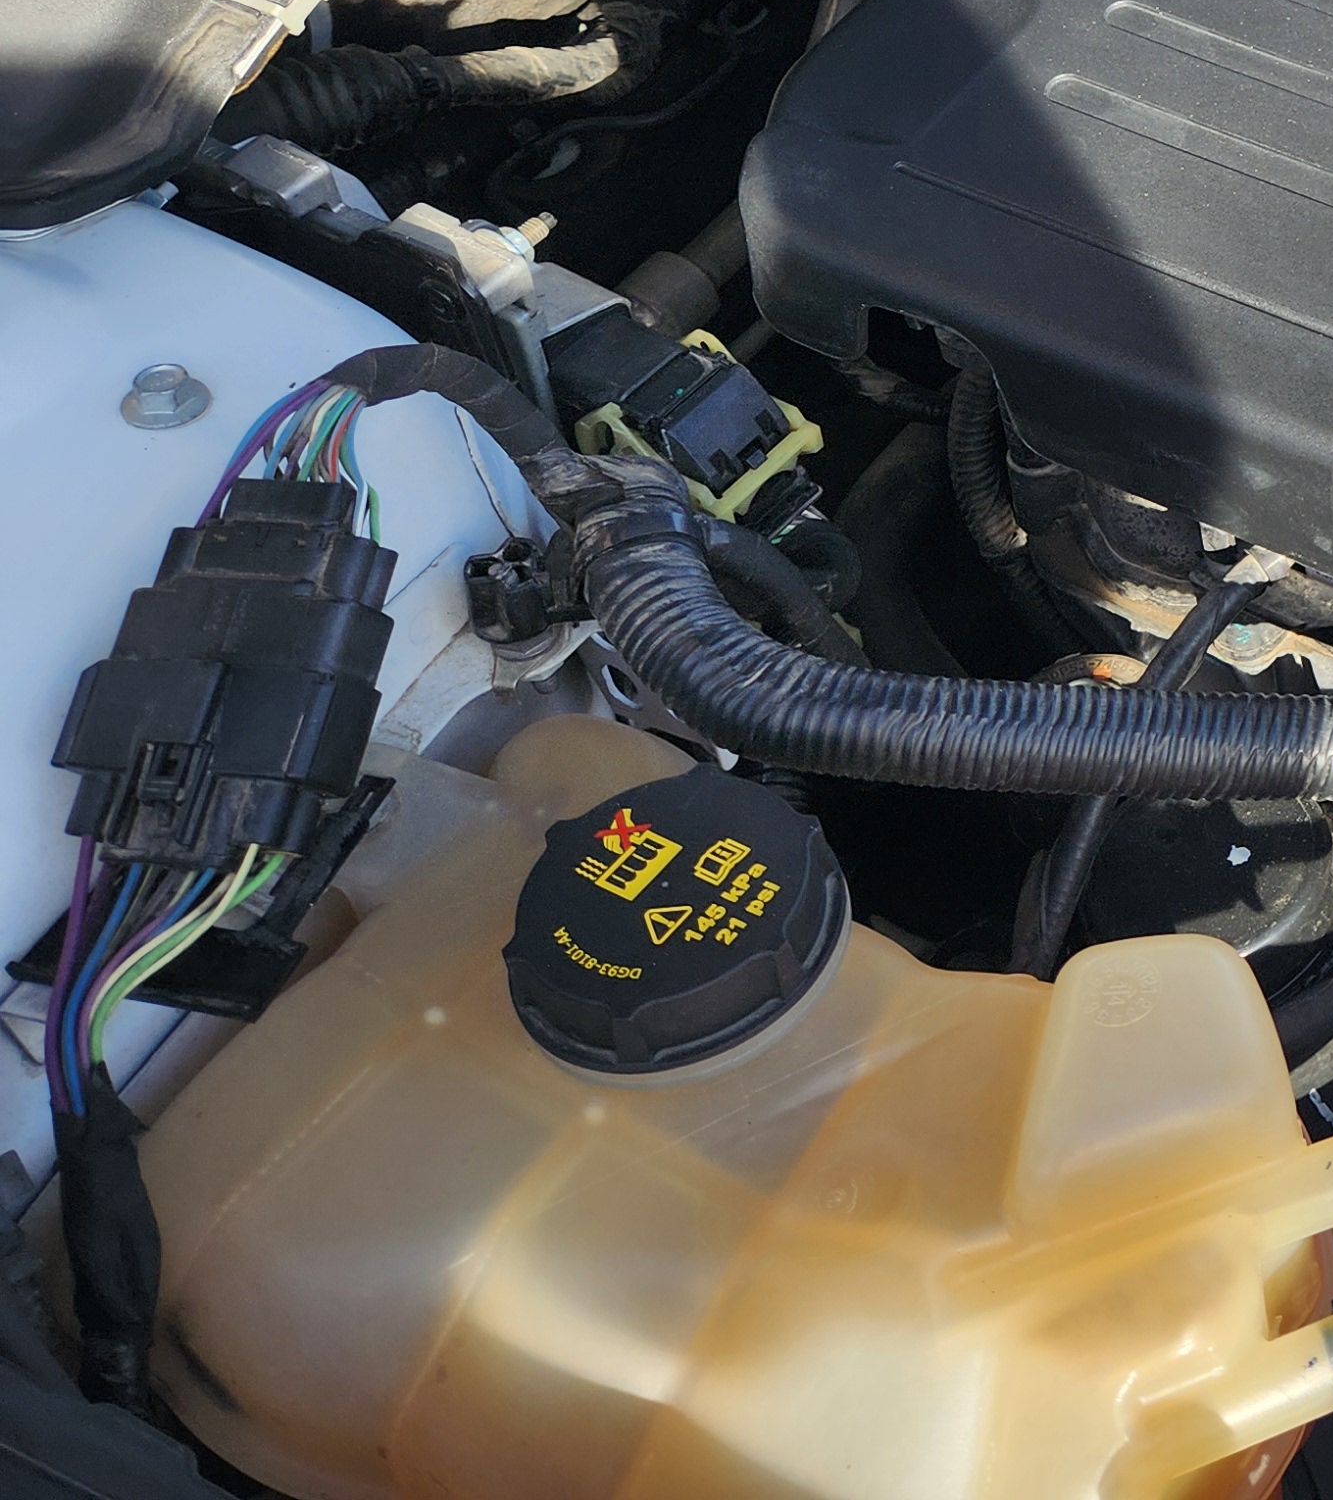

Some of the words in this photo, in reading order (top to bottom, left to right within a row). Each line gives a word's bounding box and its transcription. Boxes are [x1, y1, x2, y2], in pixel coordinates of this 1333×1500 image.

[684, 902, 727, 943] 145
[720, 862, 768, 903] kPa
[715, 916, 748, 946] 21
[745, 880, 781, 917] psi
[553, 926, 643, 980] DG93-8101-AA
